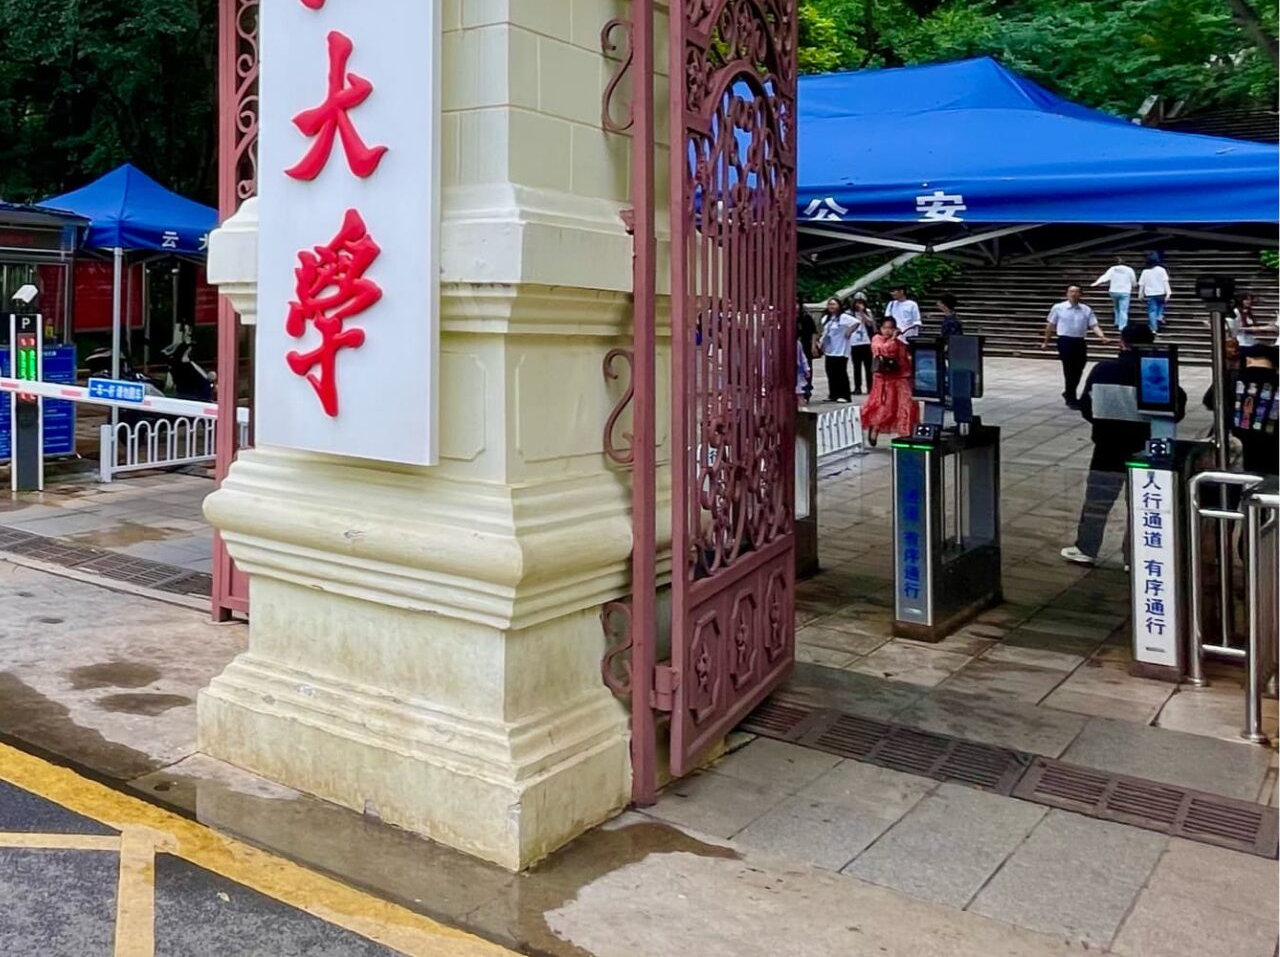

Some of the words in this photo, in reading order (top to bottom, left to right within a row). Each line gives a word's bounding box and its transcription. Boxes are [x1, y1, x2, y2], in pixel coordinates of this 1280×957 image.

[803, 191, 967, 223] 公安
[21, 317, 31, 329] P
[1142, 471, 1163, 549] 人行通道
[1144, 559, 1167, 636] 有序通行
